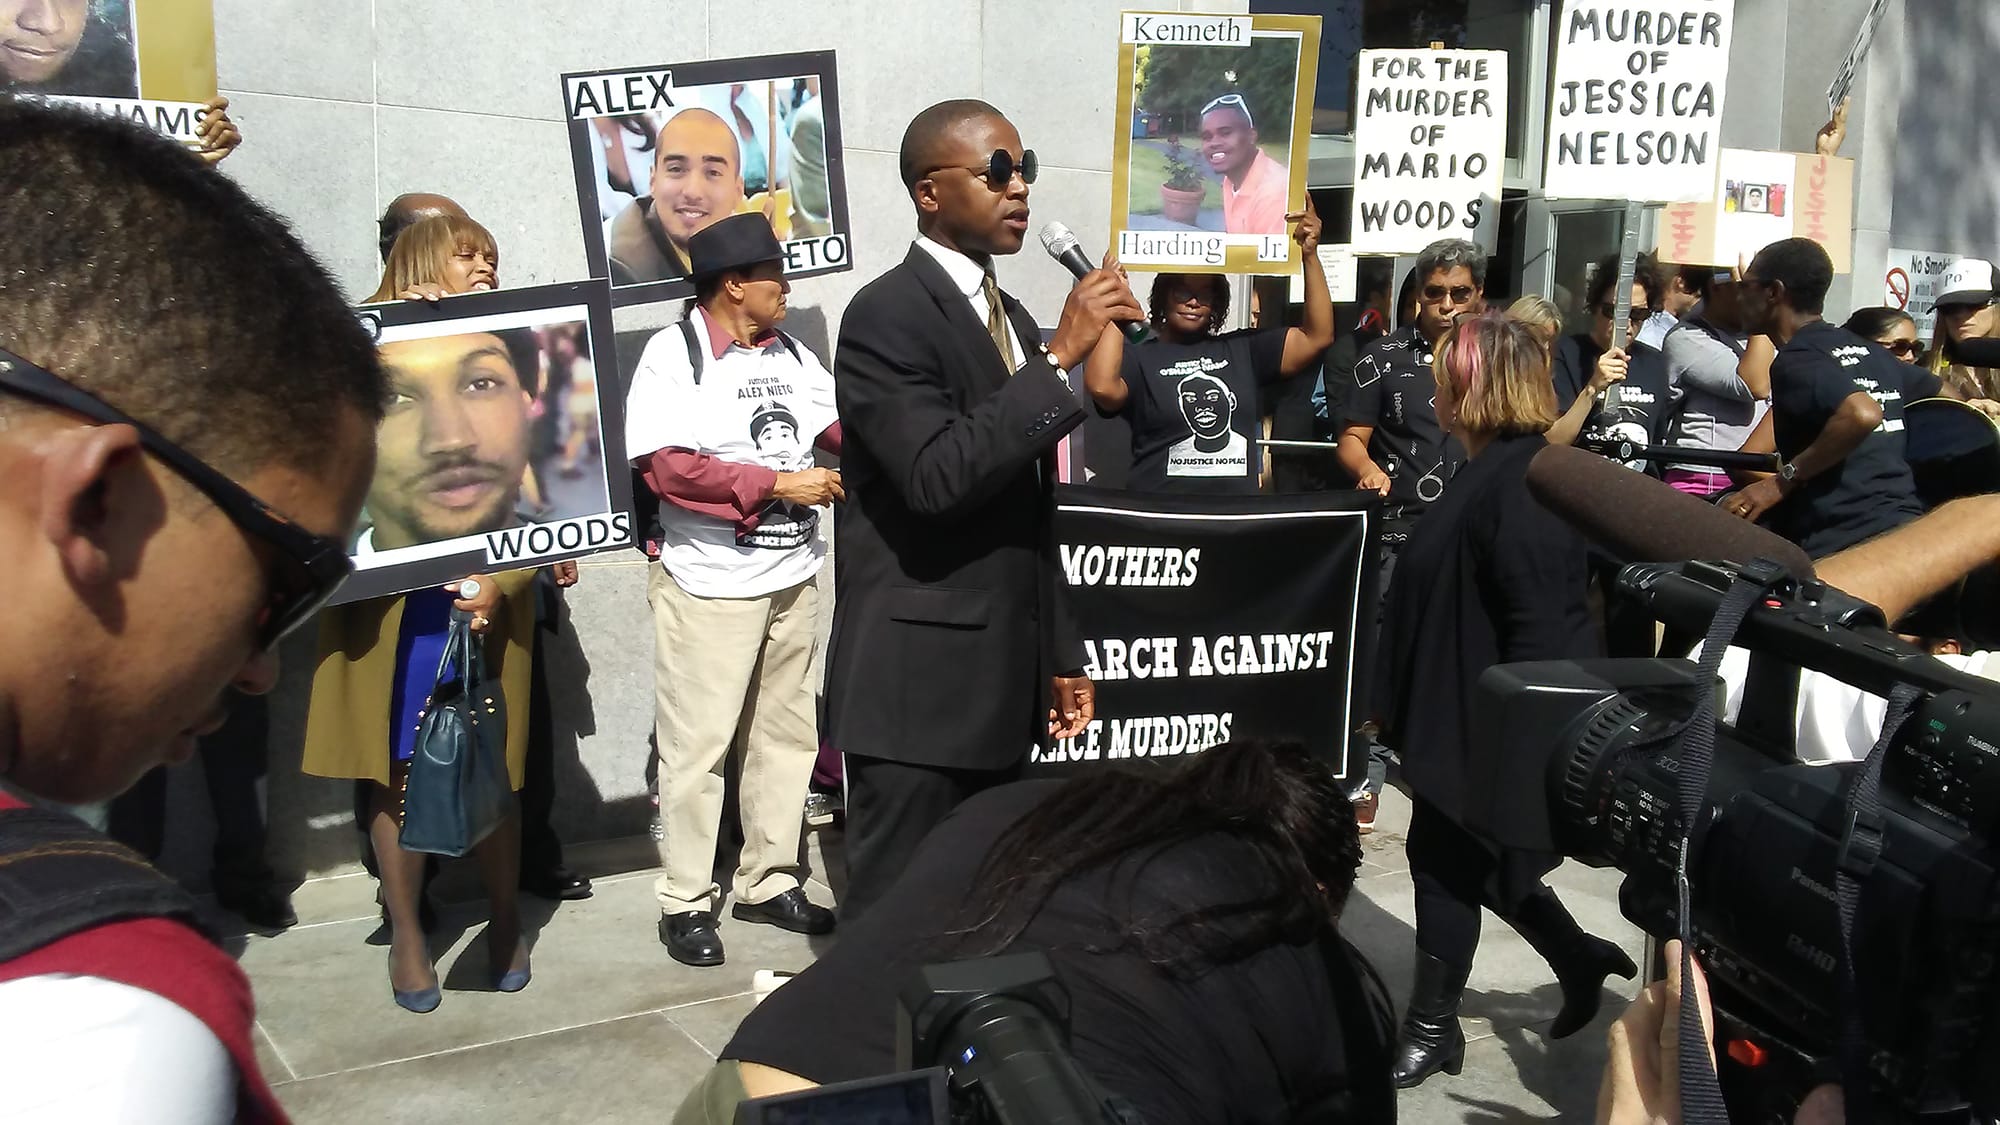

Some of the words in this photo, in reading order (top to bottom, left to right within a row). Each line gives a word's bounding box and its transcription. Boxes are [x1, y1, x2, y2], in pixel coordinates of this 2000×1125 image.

[1134, 16, 1241, 42] Kenneth
[1568, 8, 1722, 48] MURDER
[1372, 57, 1426, 79] FOR
[1435, 57, 1489, 82] THE
[1627, 50, 1669, 75] OF
[573, 73, 675, 117] ALEX
[1365, 87, 1493, 118] MURDER
[1559, 79, 1715, 118] JESSICA
[1410, 125, 1446, 147] OF
[1558, 130, 1708, 166] NELSON
[1361, 152, 1488, 180] MARIO
[1361, 199, 1483, 232] WOODS
[784, 236, 846, 270] ETO
[1121, 233, 1223, 264] Harding
[1259, 236, 1288, 259] Jr.
[1911, 254, 1923, 274] No
[1924, 256, 1953, 276] Smok
[738, 387, 763, 399] ALEX
[766, 384, 793, 397] NIETO
[486, 513, 630, 560] WOODS
[1059, 543, 1201, 588] MOTHERS
[1082, 636, 1178, 681] ARCH
[1189, 631, 1334, 677] AGAINST
[1107, 711, 1233, 759] MURDERS
[1791, 866, 1838, 901] Panaso
